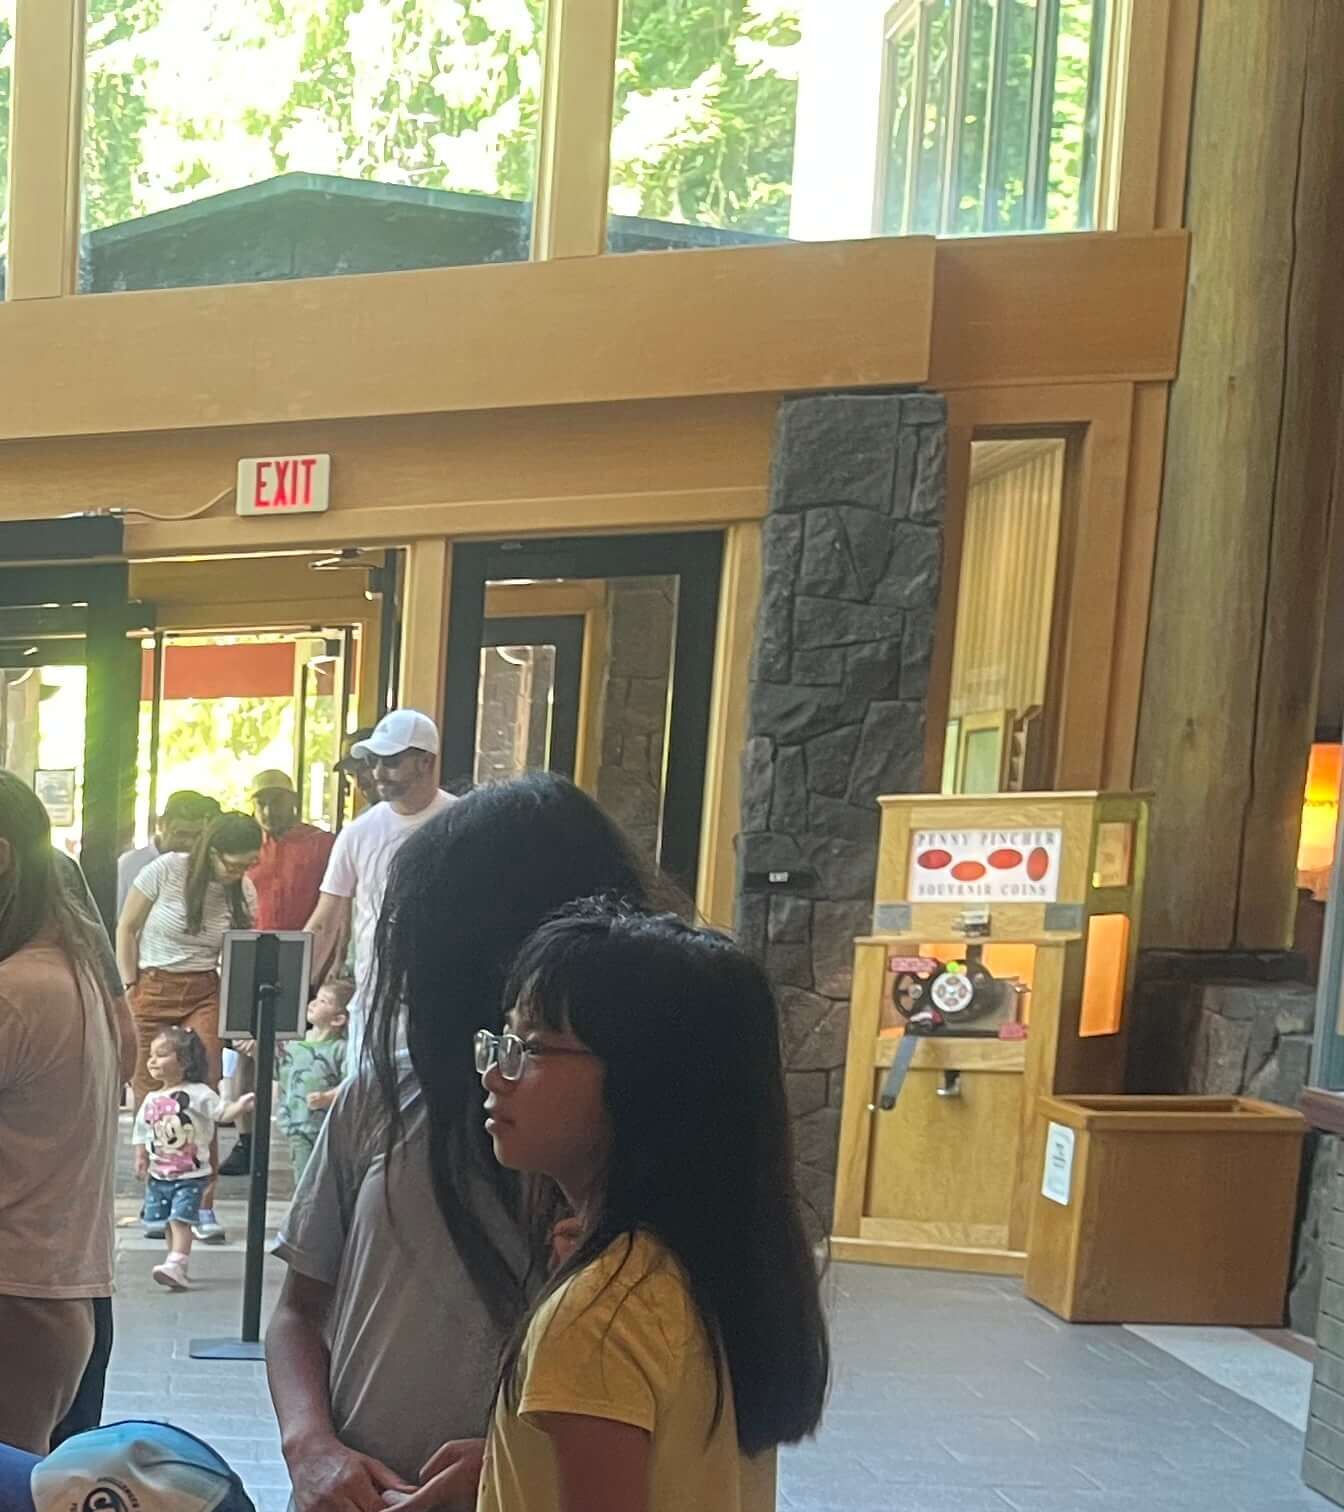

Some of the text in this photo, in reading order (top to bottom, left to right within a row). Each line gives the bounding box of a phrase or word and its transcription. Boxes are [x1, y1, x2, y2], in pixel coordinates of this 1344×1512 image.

[254, 458, 317, 507] EXIT
[917, 832, 1056, 847] PENNY PINCHER
[917, 883, 1047, 896] SOUVENIR COINS
